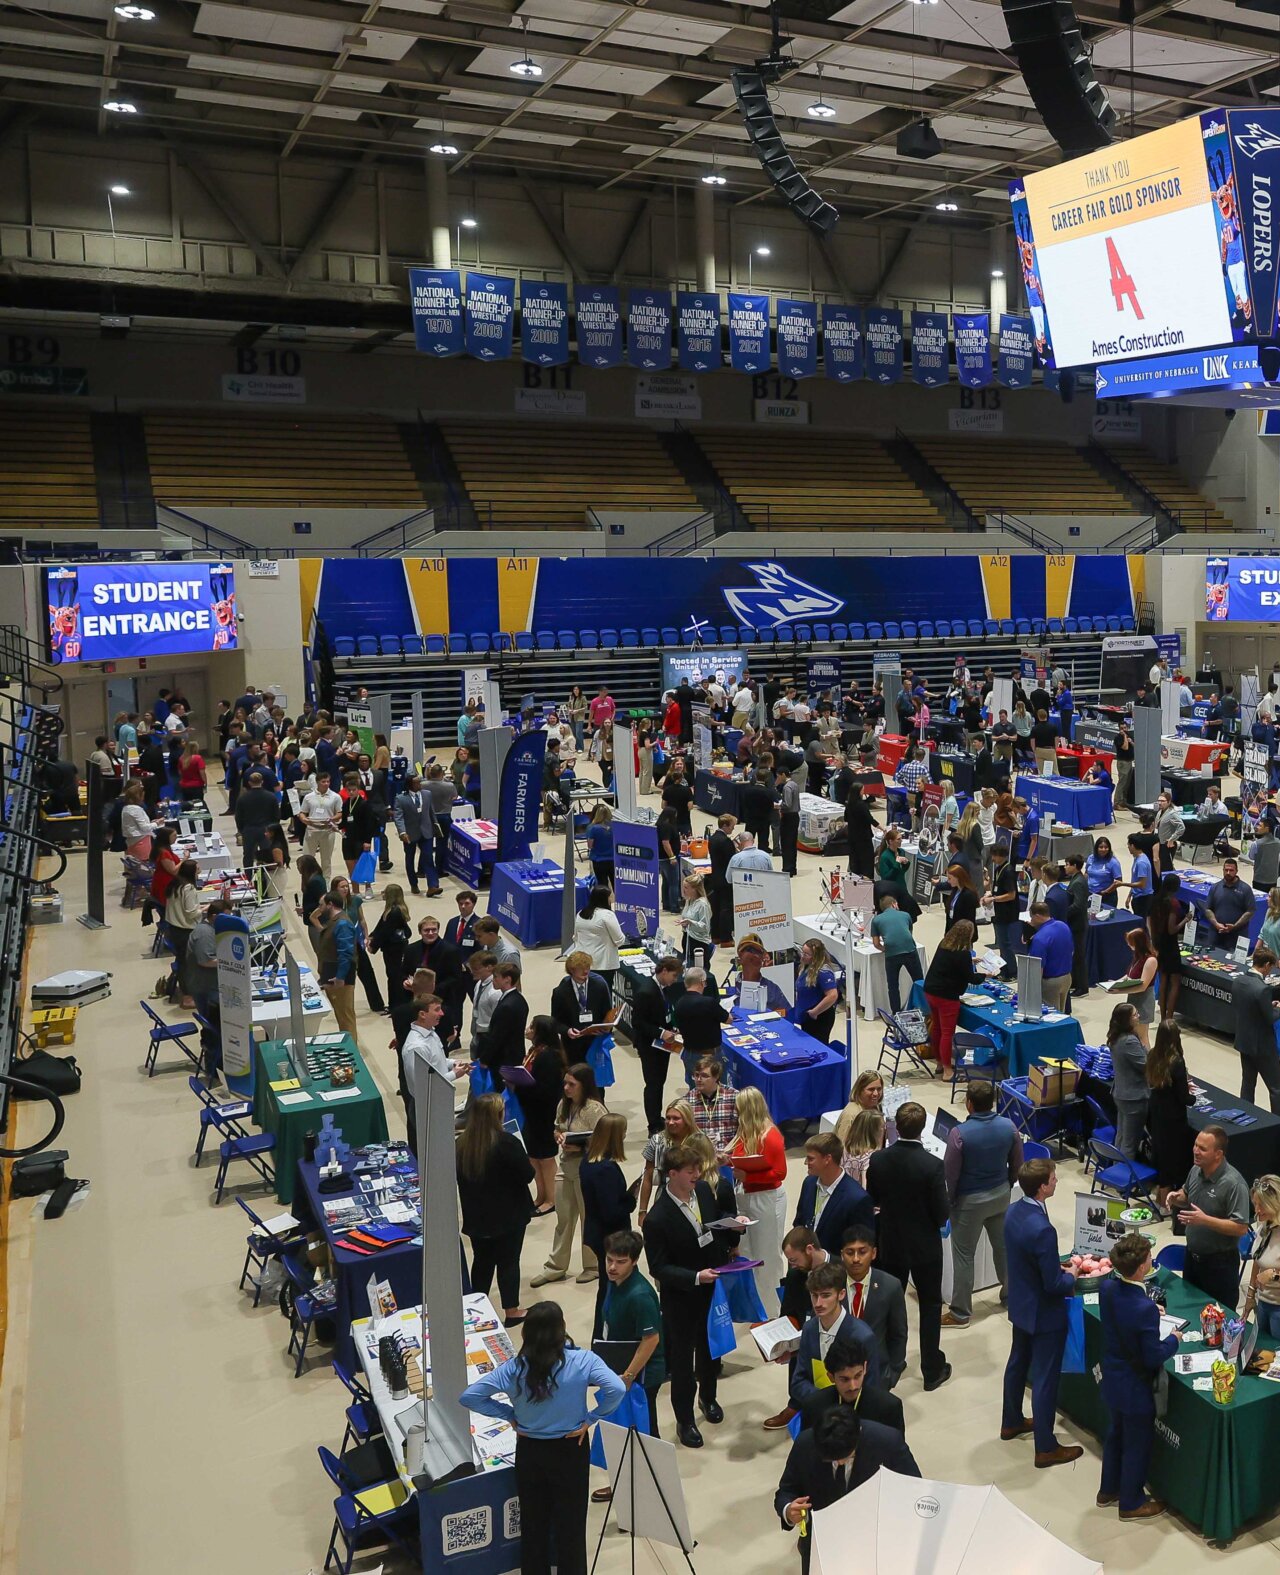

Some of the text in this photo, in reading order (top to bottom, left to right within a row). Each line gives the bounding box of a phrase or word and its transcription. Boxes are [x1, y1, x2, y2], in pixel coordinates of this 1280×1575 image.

[1084, 160, 1130, 189] THANK YOU
[1051, 177, 1182, 232] CAREER FAIR GOLD SPONSOR
[1252, 173, 1272, 273] LOPERS
[416, 286, 456, 299] NATIONAL
[470, 290, 508, 306] NATIONAL
[414, 297, 460, 309] RUNNER-UP
[467, 300, 512, 315] RUNNER-UP
[525, 299, 562, 311] NATIONAL
[579, 302, 616, 314] NATIONAL
[471, 311, 506, 323] WRESTLING
[523, 308, 566, 321] RUNNER-UP
[632, 304, 667, 317] NATIONAL
[681, 308, 715, 320] NATIONAL
[733, 310, 765, 322] NATIONAL
[527, 318, 561, 328] WRESTLING
[577, 311, 619, 324] RUNNER-UP
[629, 315, 670, 327] RUNNER-UP
[679, 318, 719, 330] RUNNER-UP
[781, 315, 813, 328] NATIONAL
[425, 318, 452, 334] 1978
[473, 323, 503, 339] 2003
[582, 320, 615, 330] WRESTLING
[633, 324, 665, 334] WRESTLING
[684, 326, 715, 337] WRESTLING
[778, 325, 816, 338] RUNNER-UP
[826, 320, 858, 332] NATIONAL
[868, 323, 900, 336] NATIONAL
[783, 333, 809, 344] SOFTBALL
[824, 329, 861, 341] RUNNER-UP
[866, 331, 902, 344] RUNNER-UP
[915, 327, 944, 338] NATIONAL
[957, 328, 985, 339] NATIONAL
[1002, 330, 1030, 343] NATIONAL
[586, 332, 613, 347] 2007
[830, 338, 855, 348] SOFTBALL
[912, 336, 947, 347] RUNNER-UP
[955, 337, 989, 348] RUNNER-UP
[999, 338, 1033, 351] RUNNER-UP
[1092, 326, 1184, 357] Ames Construction
[1114, 355, 1231, 384] UNIVERSITY OF NEBRASKA UNK
[93, 581, 203, 604] STUDENT
[83, 610, 210, 637] ENTRANCE
[670, 657, 700, 665] Rooted
[711, 656, 742, 664] Service
[351, 712, 367, 723] Lutz
[1245, 751, 1267, 766] GRAND
[1245, 769, 1267, 784] ISLAND
[514, 773, 528, 833] FARMERS
[617, 845, 641, 856] INVEST IN
[614, 867, 655, 885] COMMUNITY.
[750, 914, 786, 926] EMPOWERING
[769, 922, 790, 930] PEOPLE
[1190, 978, 1215, 997] FOUNDATION
